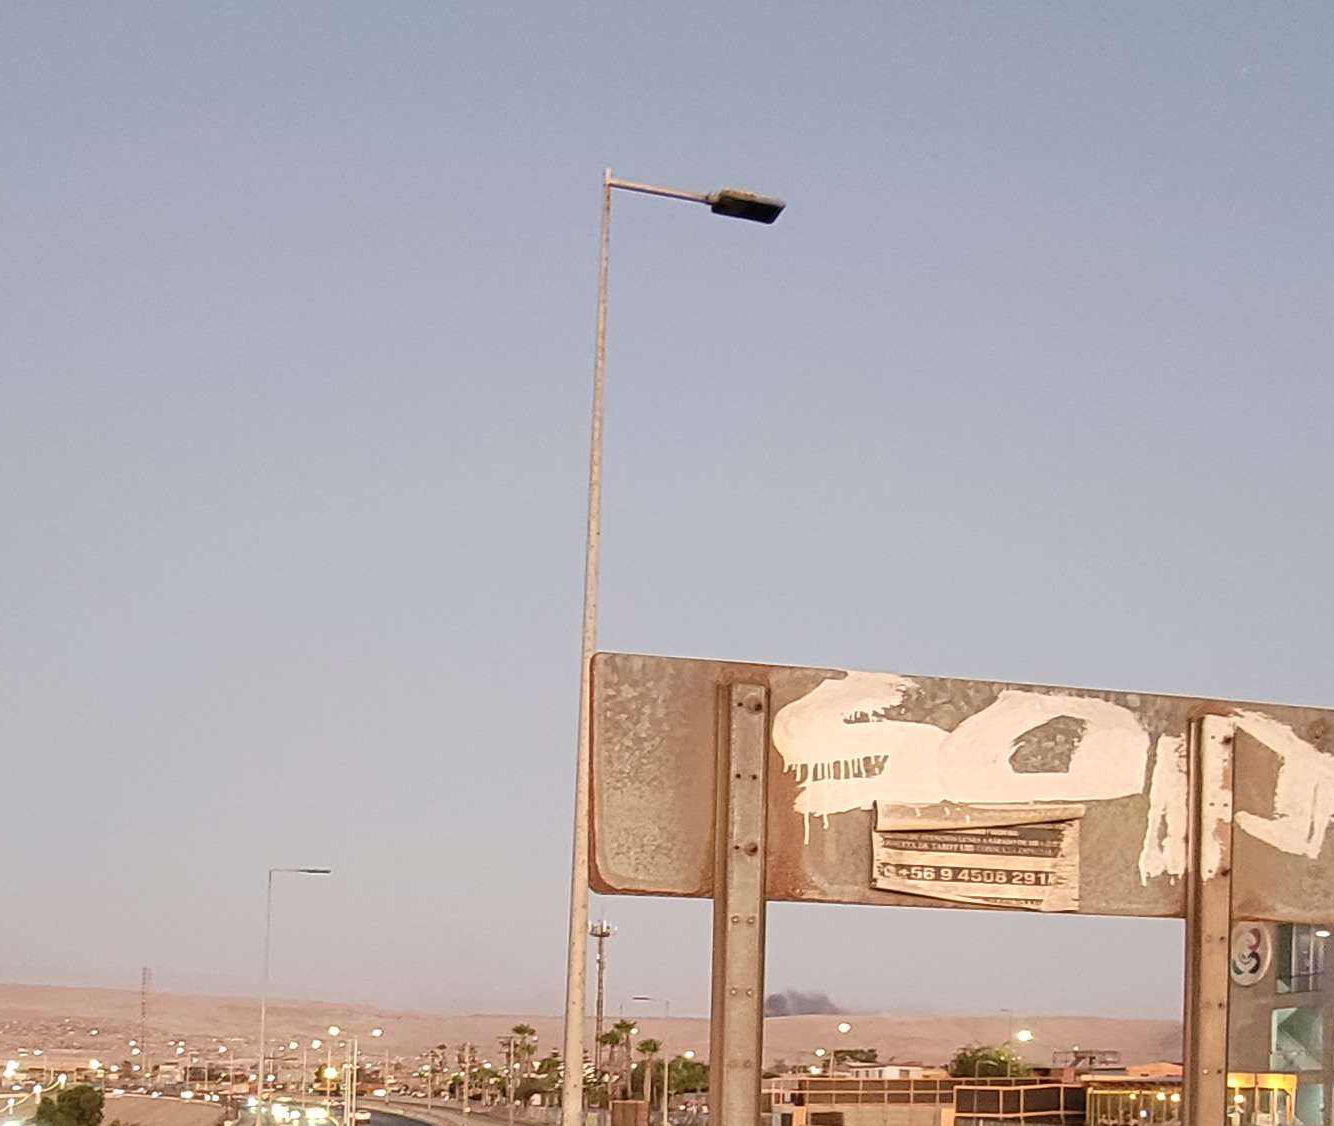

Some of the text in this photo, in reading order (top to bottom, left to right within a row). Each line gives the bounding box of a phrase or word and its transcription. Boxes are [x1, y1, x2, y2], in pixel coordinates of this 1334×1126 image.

[898, 866, 935, 880] +56
[940, 868, 953, 881] 9
[957, 869, 1008, 884] 4508
